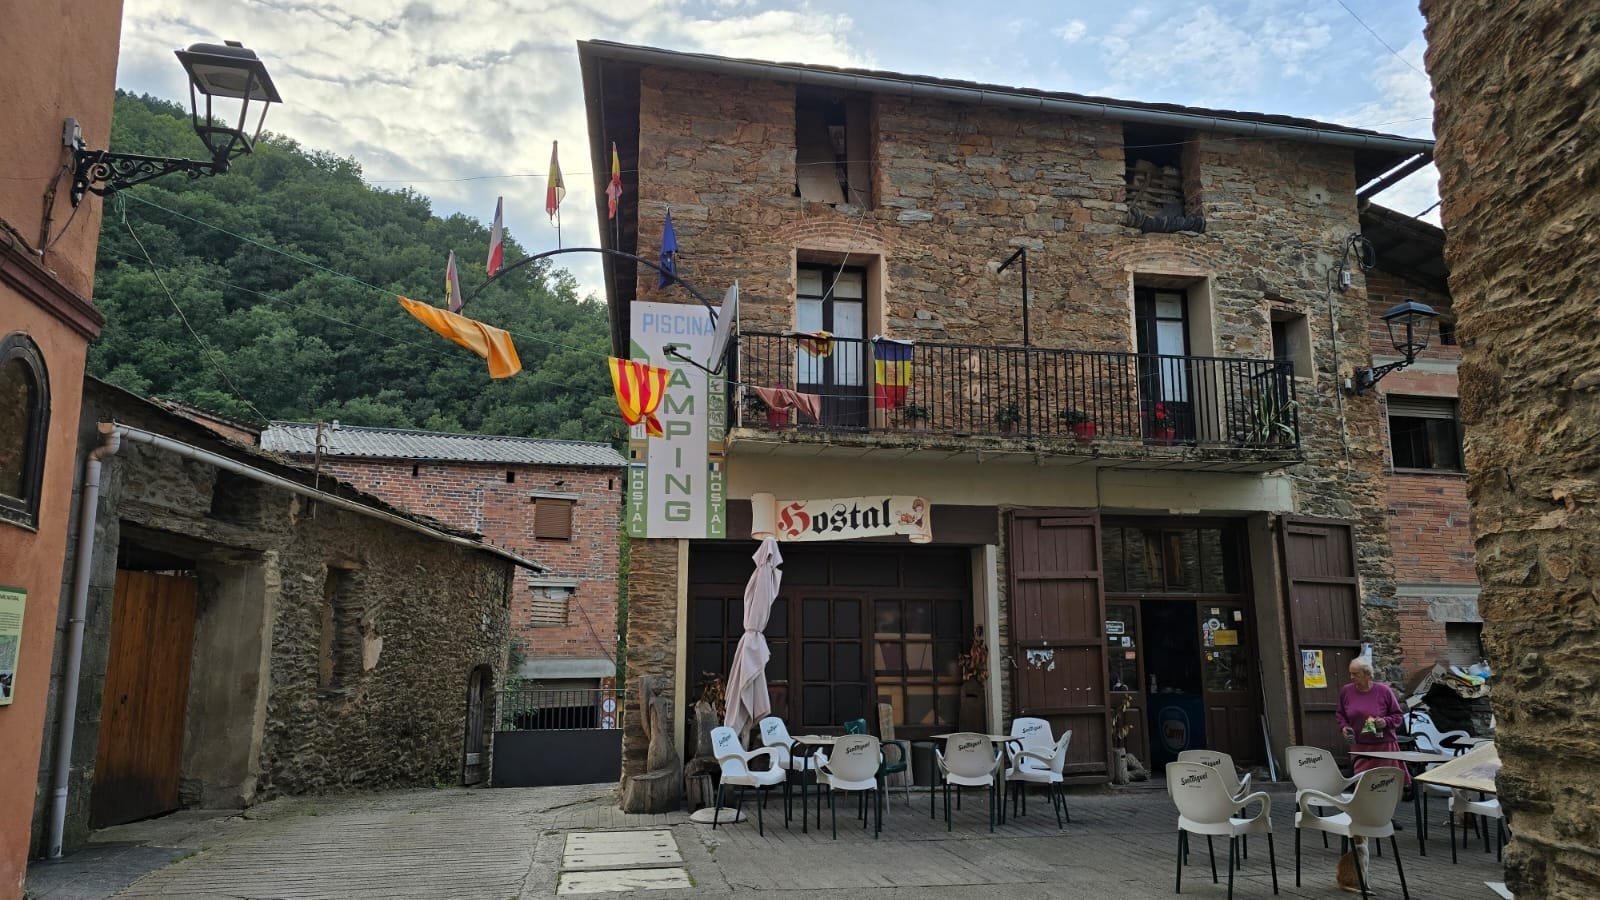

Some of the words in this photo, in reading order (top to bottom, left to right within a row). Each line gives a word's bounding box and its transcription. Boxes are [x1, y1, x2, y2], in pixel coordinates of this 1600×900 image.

[643, 313, 715, 337] PISCINA
[664, 342, 695, 522] CAMPING
[632, 470, 644, 533] HOSTAL
[710, 471, 723, 534] HOSTAL
[777, 498, 892, 539] Hostal
